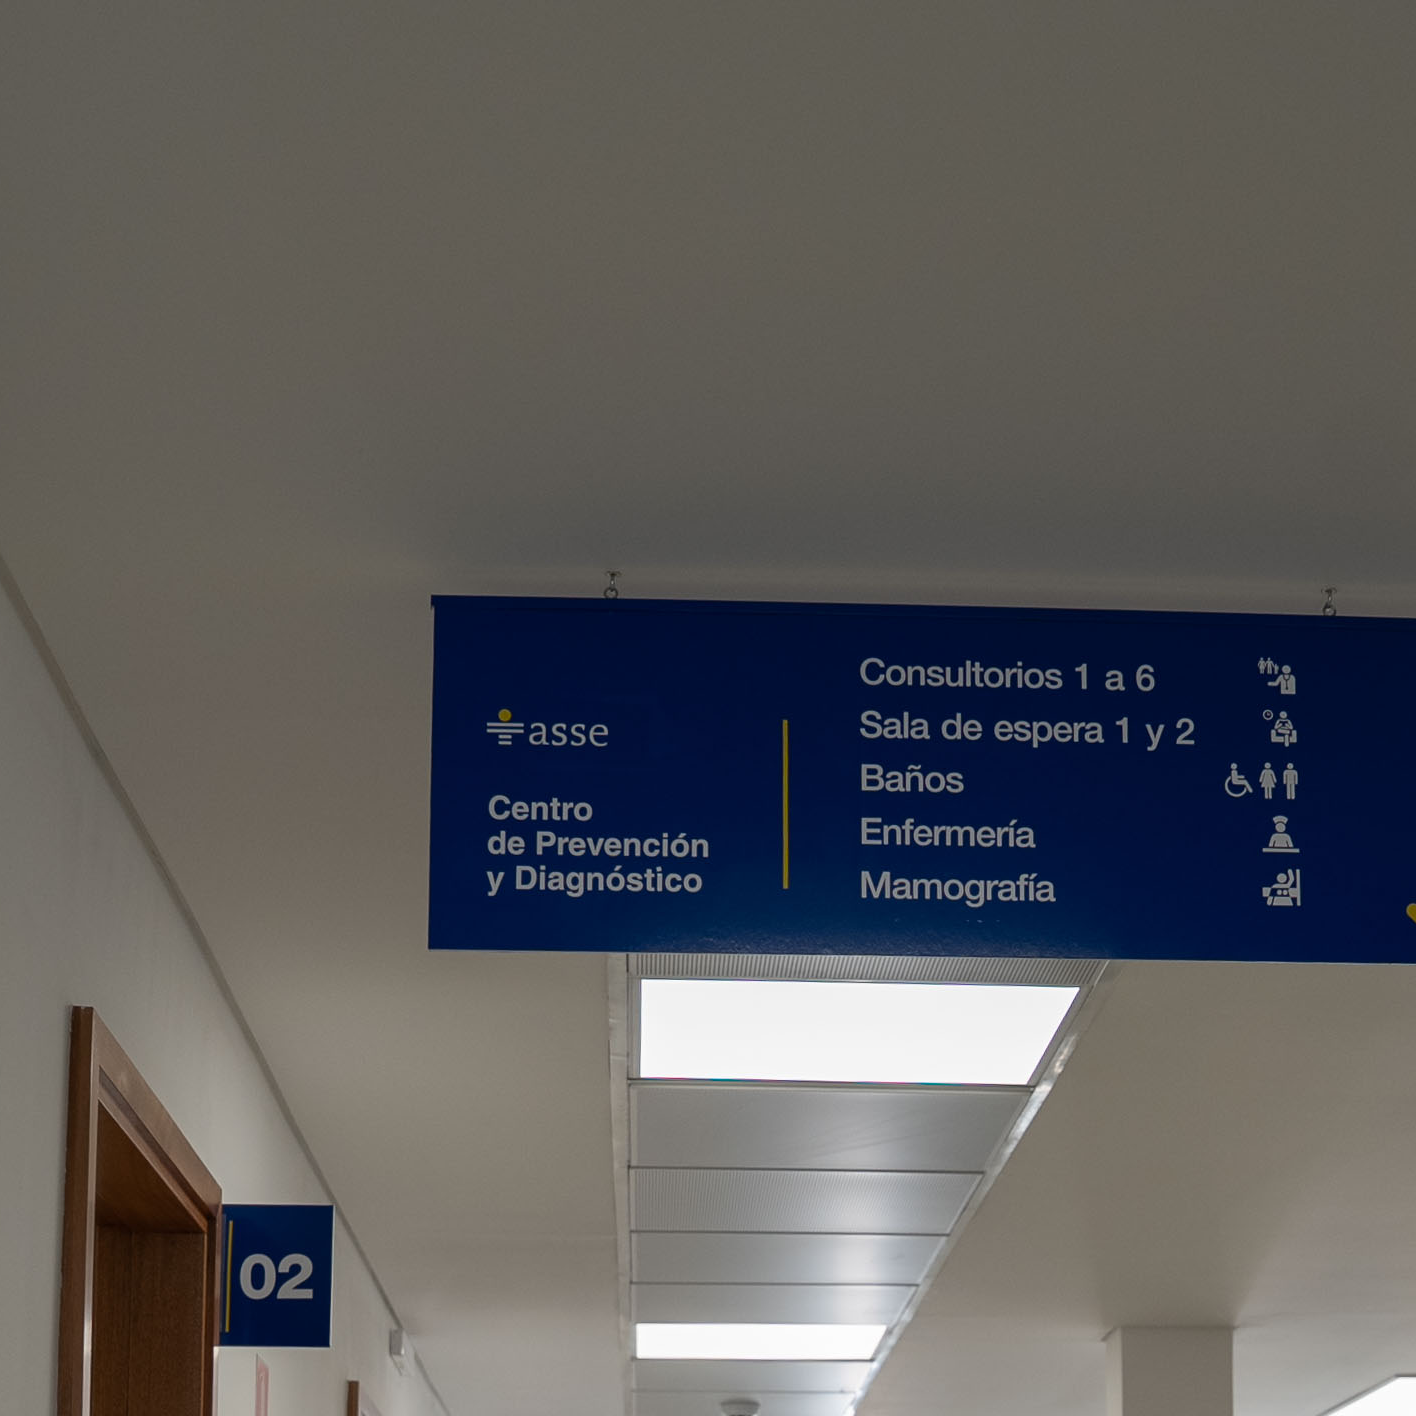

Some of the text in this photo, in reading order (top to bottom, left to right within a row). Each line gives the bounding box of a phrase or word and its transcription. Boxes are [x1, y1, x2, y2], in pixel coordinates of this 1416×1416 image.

[859, 657, 1156, 692] Consultorios 1 a 6
[528, 722, 609, 747] asse
[859, 710, 1196, 752] Sala de espera 1 y 2
[860, 763, 965, 794] Baños
[488, 794, 593, 822] Centro
[487, 830, 709, 859] de Prevención
[860, 817, 1037, 852] Enfermería
[486, 865, 703, 898] y Diagnóstico
[860, 870, 1057, 908] Mamografía
[239, 1253, 314, 1300] 02
